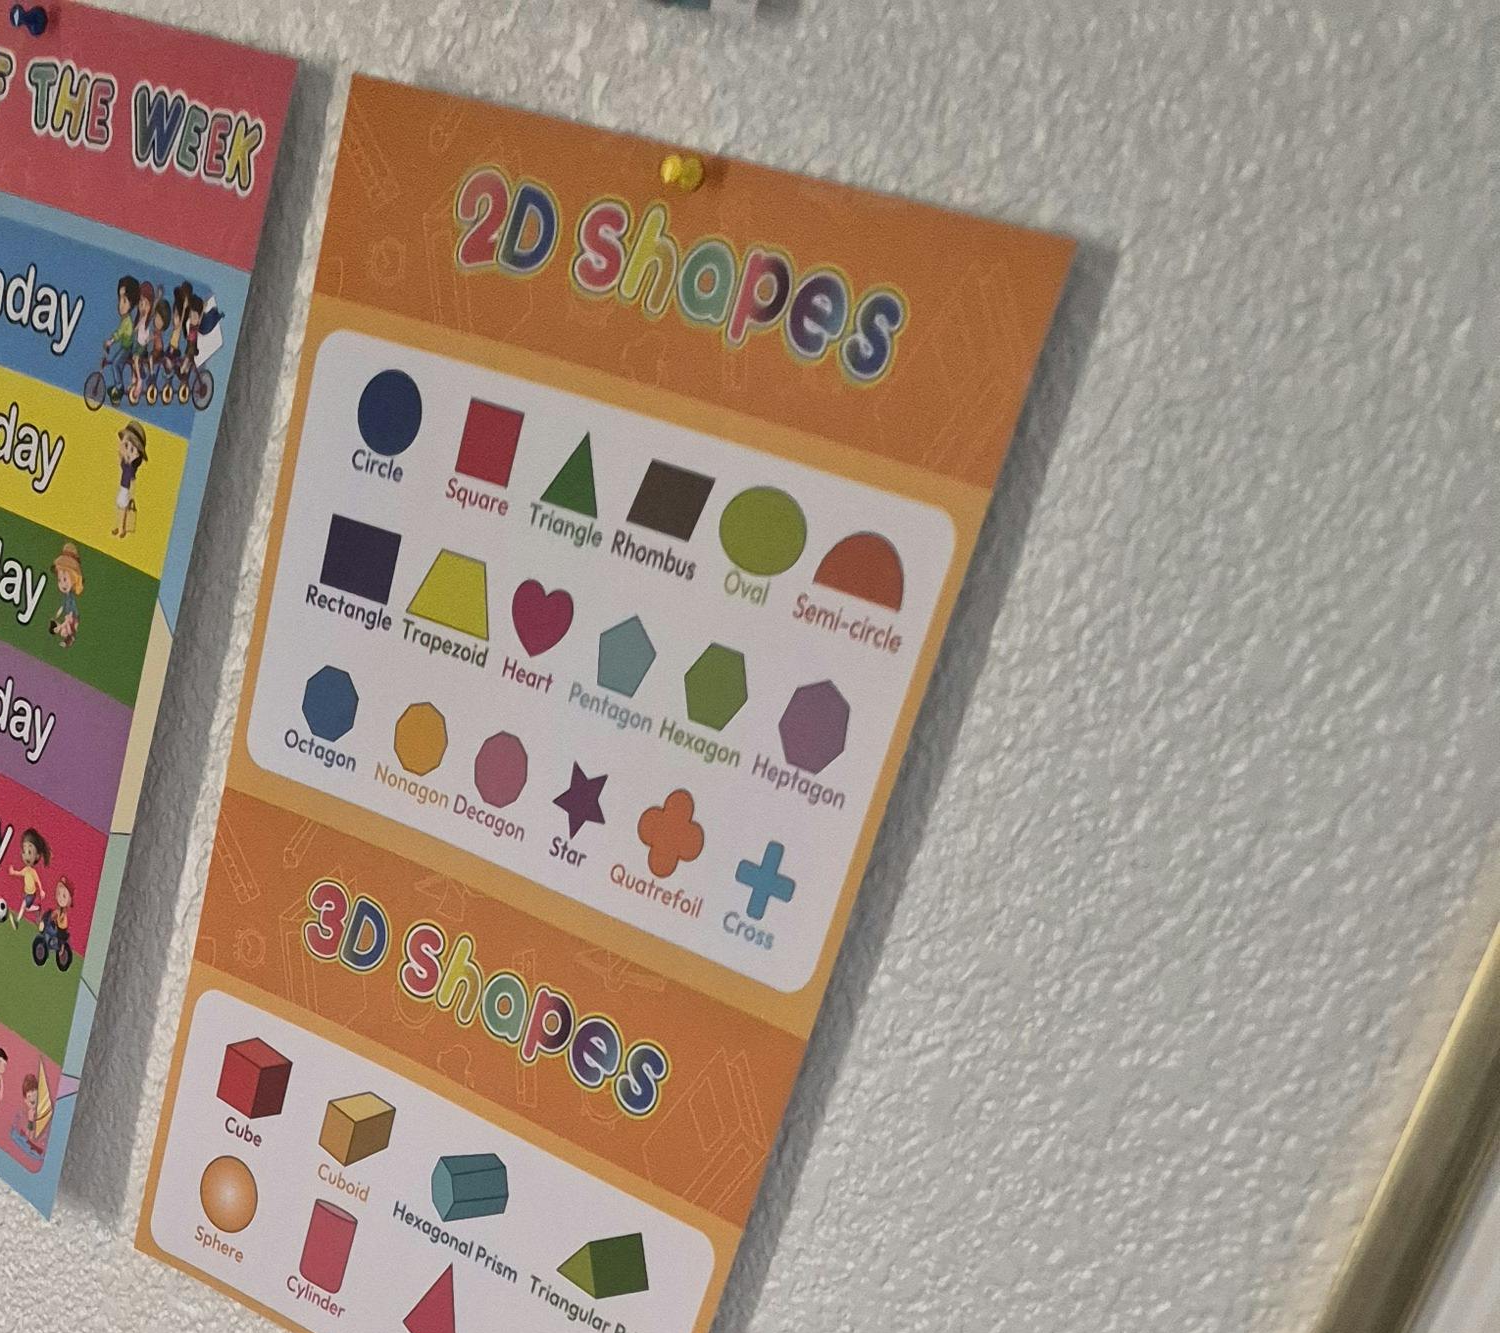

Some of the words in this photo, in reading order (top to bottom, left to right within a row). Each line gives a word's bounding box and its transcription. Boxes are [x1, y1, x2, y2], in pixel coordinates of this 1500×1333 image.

[25, 60, 118, 151] THE
[129, 84, 265, 196] WEEK
[454, 164, 560, 276] 2D
[351, 449, 404, 484] Circle
[445, 477, 509, 518] Square
[530, 502, 603, 550] Triangle
[611, 530, 697, 582] Rhombus
[305, 585, 393, 631] Rectangle
[723, 571, 770, 607] Oval
[402, 620, 490, 669] Trapezoid
[793, 594, 902, 654] Semi-circle
[501, 657, 555, 694] Heart
[569, 683, 654, 735] Pentagon
[283, 728, 359, 774] Octagon
[658, 718, 741, 772] Hexagon
[374, 762, 451, 811] Nonagon
[752, 755, 846, 810] Heptagon
[453, 794, 526, 845] Decagon
[549, 835, 587, 869] Star
[610, 862, 704, 921] Quatrefoil
[302, 875, 391, 975] 3D
[722, 912, 775, 952] Cross
[224, 1115, 263, 1149] Cube
[317, 1162, 371, 1205] Cuboid
[194, 1224, 244, 1265] Sphere
[393, 1200, 475, 1259] Hexagonal
[474, 1237, 519, 1284] Prism
[286, 1274, 347, 1321] Cylinder
